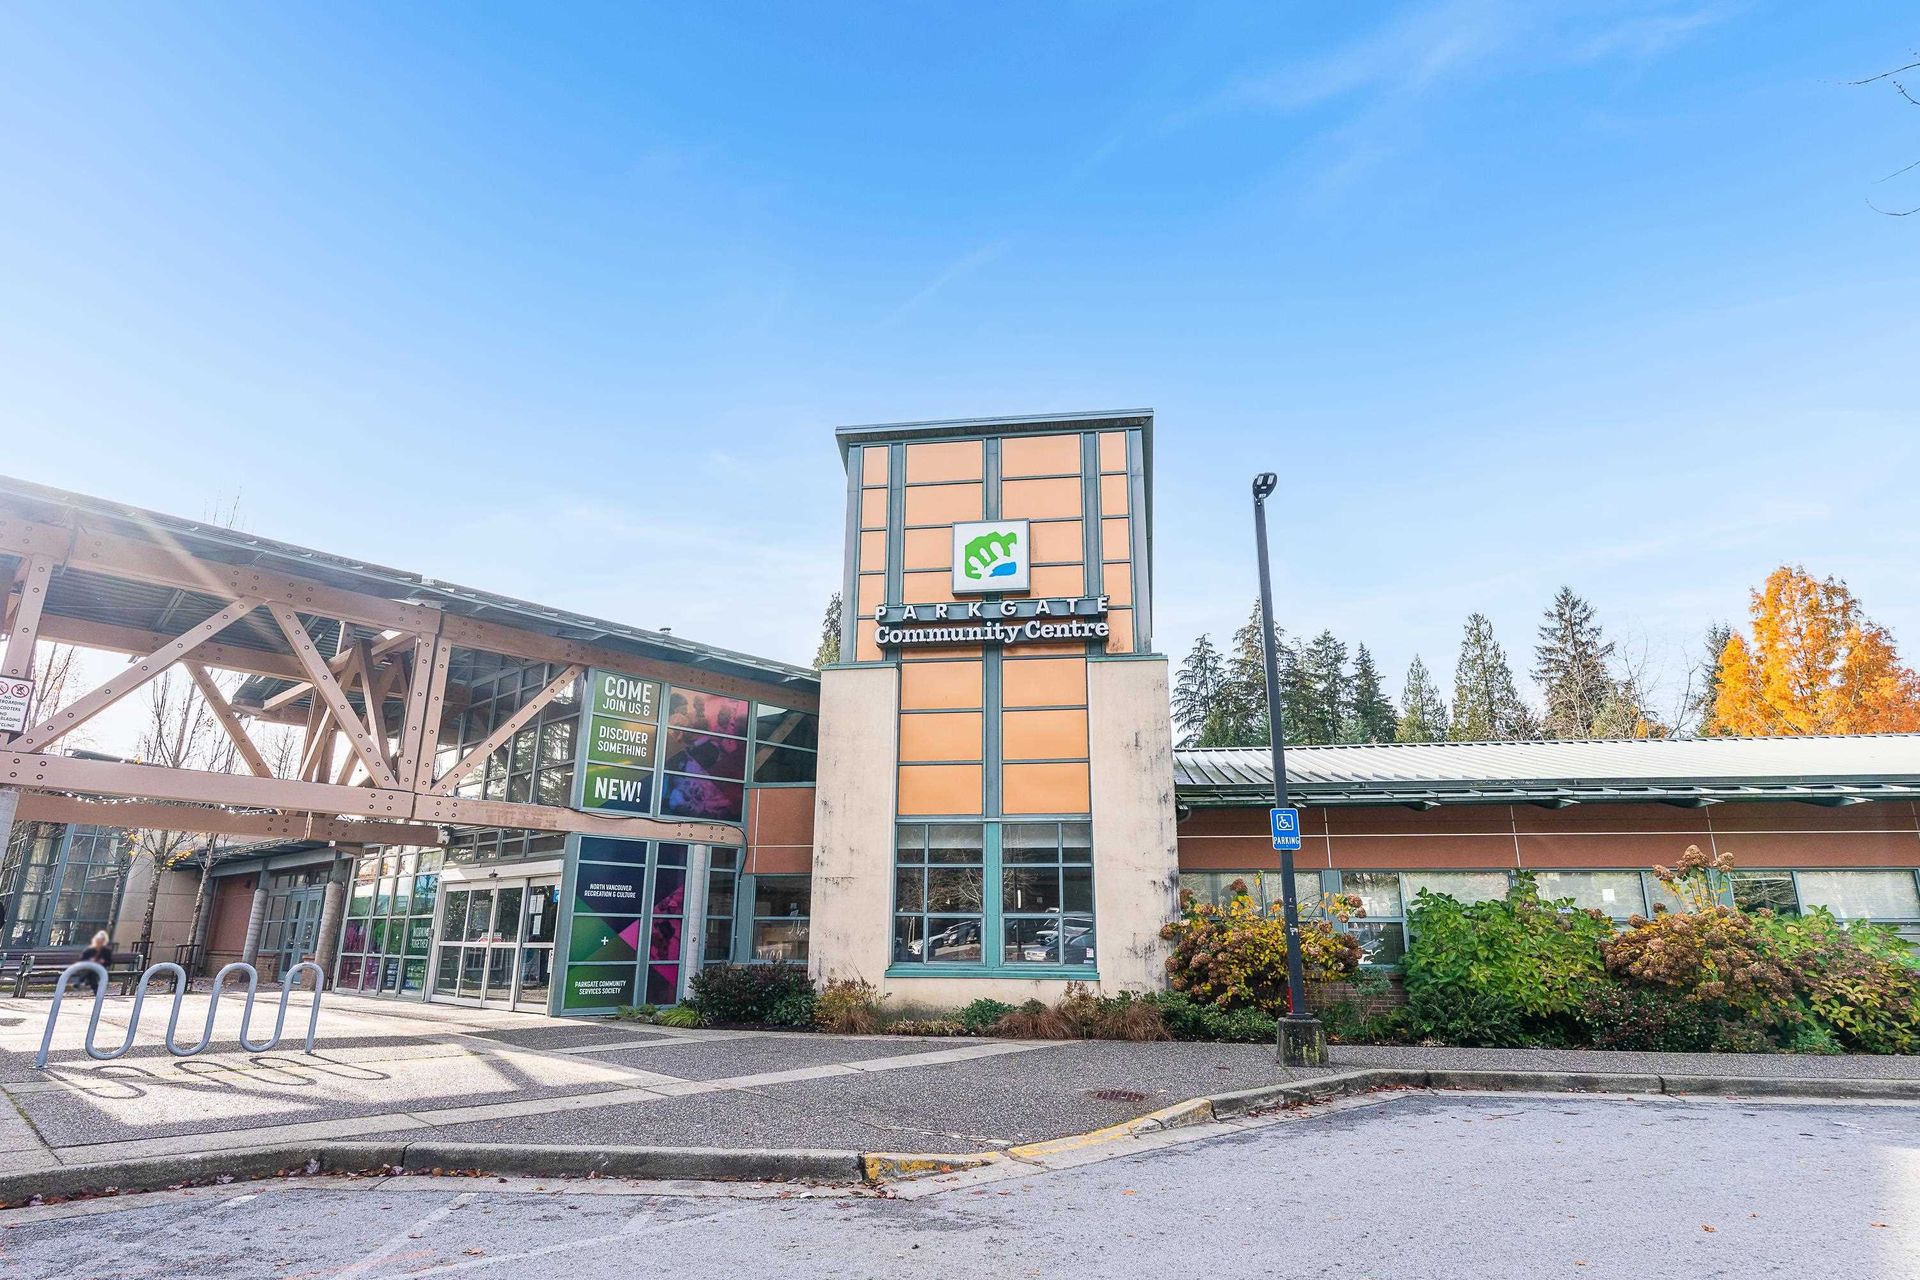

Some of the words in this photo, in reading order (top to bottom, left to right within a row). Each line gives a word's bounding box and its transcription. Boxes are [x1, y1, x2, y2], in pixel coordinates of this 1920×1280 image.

[875, 598, 1107, 620] PARKGATE
[875, 621, 1022, 644] Community
[1025, 619, 1109, 639] Centre
[604, 676, 652, 703] COME
[602, 698, 627, 713] JOIN
[628, 702, 642, 715] US
[643, 704, 650, 716] &
[599, 726, 648, 744] DISCOVER
[597, 741, 647, 757] SOMETHING
[594, 777, 642, 802] NEW!
[1274, 836, 1299, 844] PARKING
